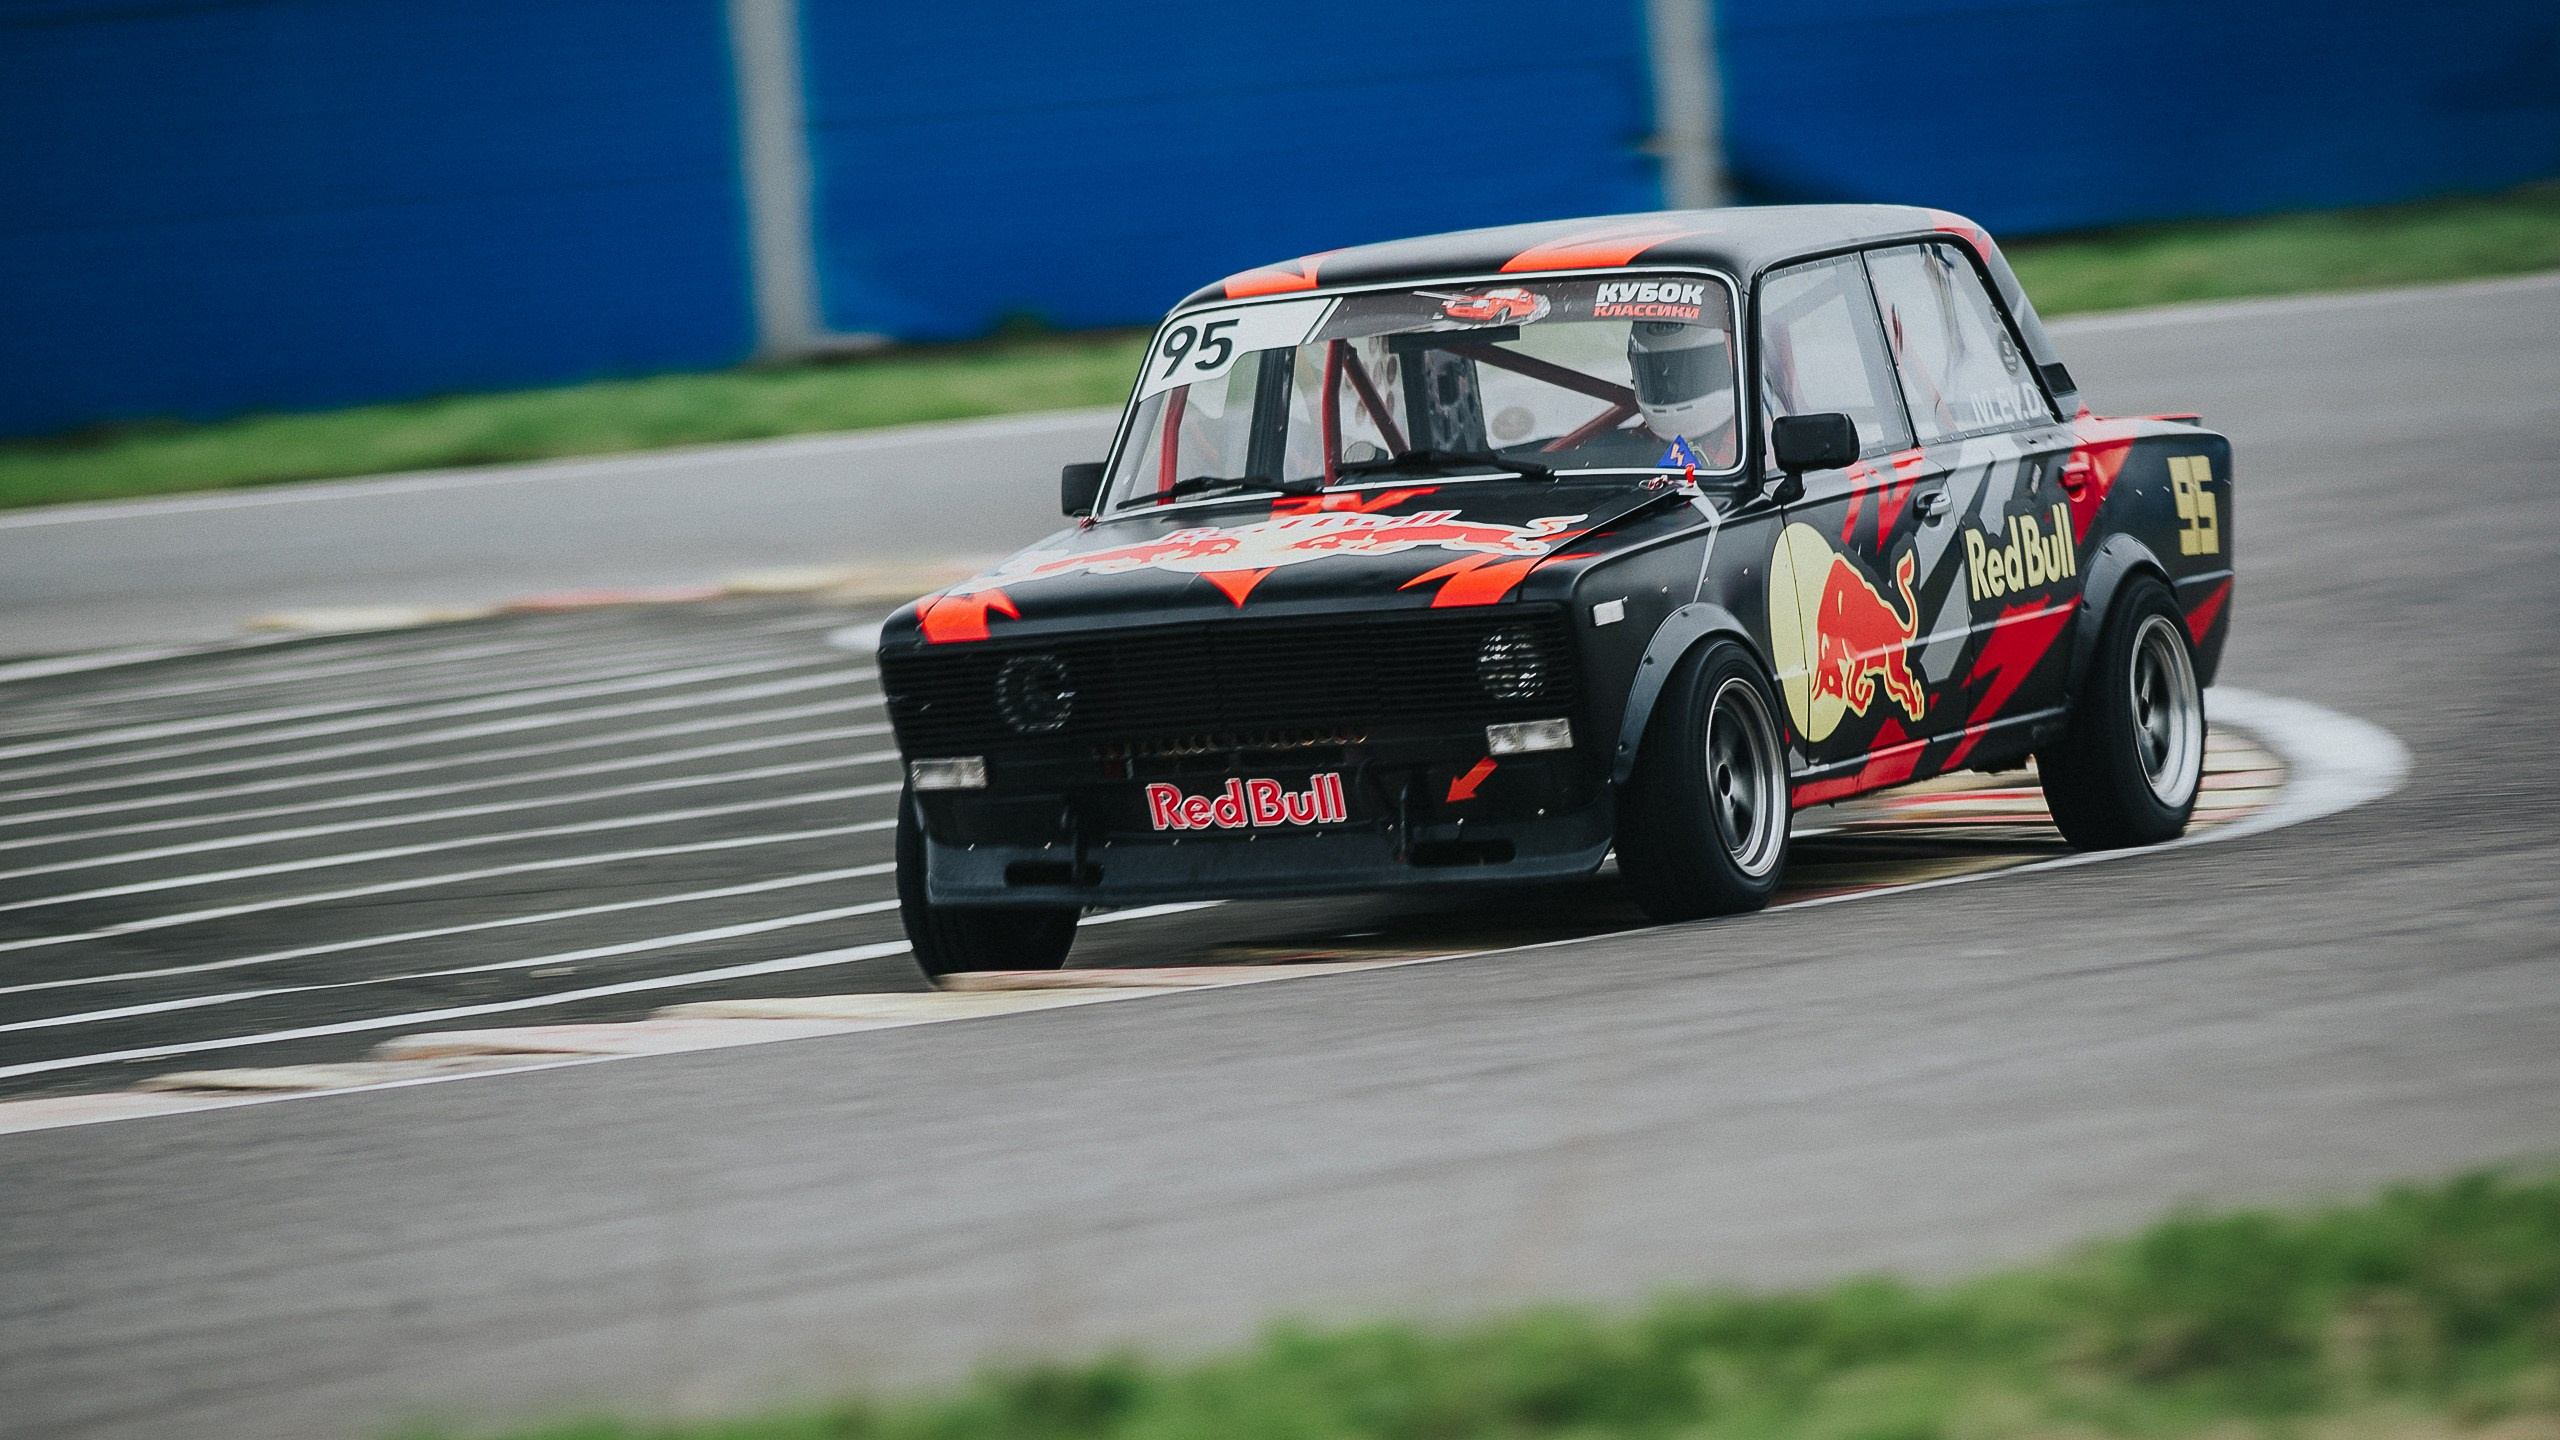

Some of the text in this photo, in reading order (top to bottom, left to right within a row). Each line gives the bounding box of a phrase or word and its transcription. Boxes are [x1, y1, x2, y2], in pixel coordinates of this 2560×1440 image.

[1593, 304, 1700, 320] КЛАССИКИ
[1595, 282, 1705, 306] КУБОК
[1161, 318, 1240, 380] 95
[2167, 455, 2220, 556] 95
